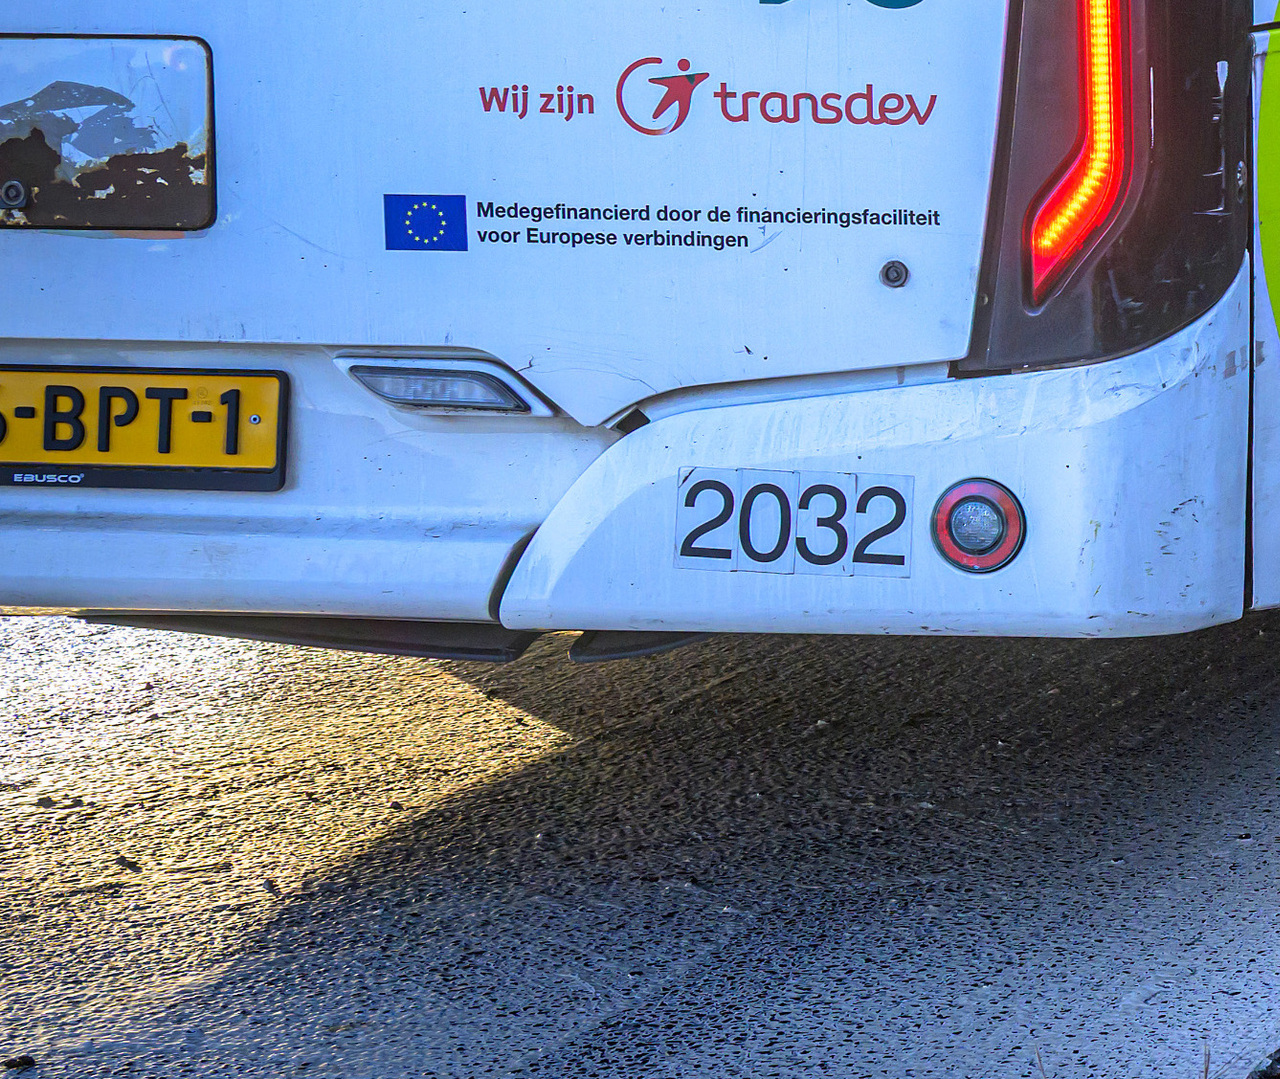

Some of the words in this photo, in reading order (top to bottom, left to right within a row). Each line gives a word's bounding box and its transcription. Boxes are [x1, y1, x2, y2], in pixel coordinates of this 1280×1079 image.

[479, 84, 529, 120] Wij
[539, 84, 595, 122] zijn
[713, 82, 938, 126] transdev
[476, 201, 651, 223] Medegefinancierd
[656, 205, 702, 222] door
[706, 206, 731, 223] de
[736, 206, 941, 228] financieringsfaciliteit
[476, 229, 521, 243] voor
[526, 227, 618, 247] Europese
[623, 230, 749, 251] verbindingen
[0, 384, 241, 456] -BPT-1
[679, 479, 908, 566] 2032
